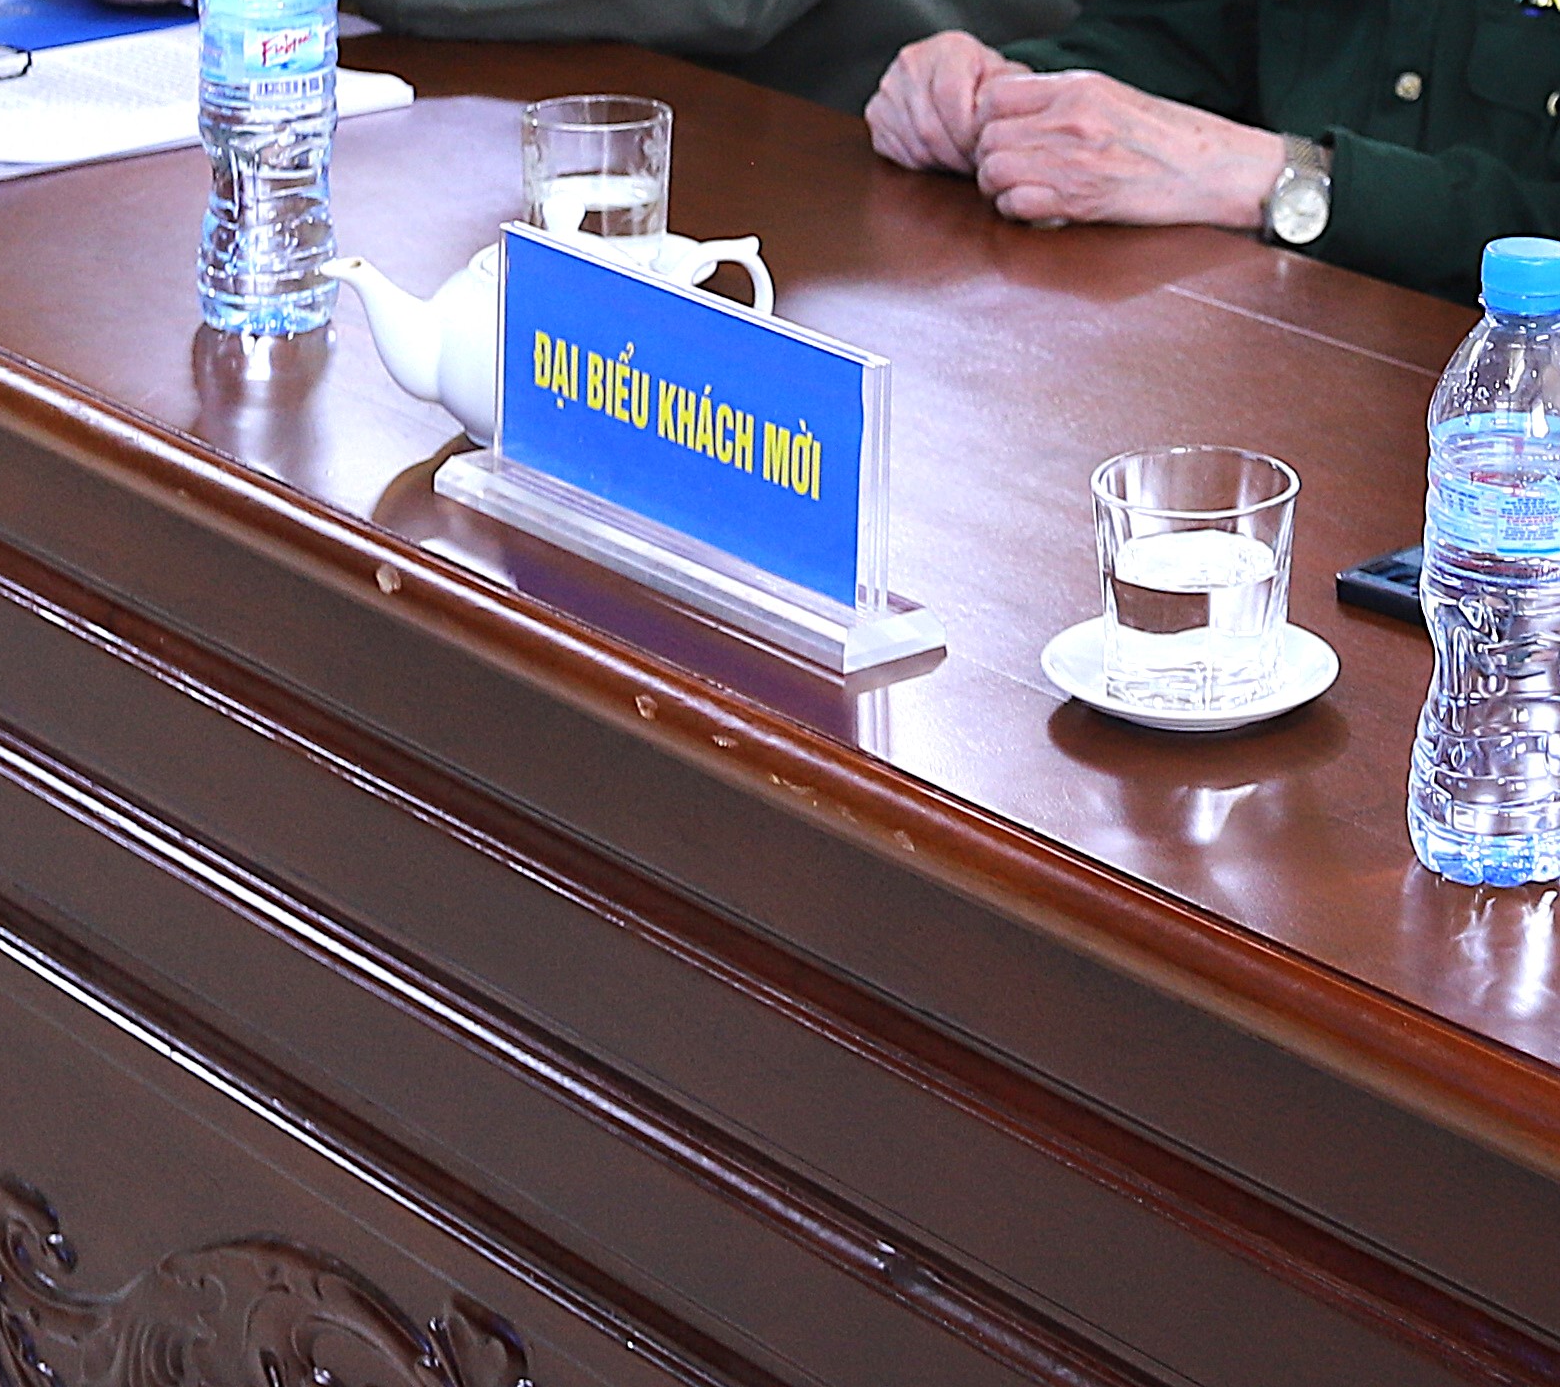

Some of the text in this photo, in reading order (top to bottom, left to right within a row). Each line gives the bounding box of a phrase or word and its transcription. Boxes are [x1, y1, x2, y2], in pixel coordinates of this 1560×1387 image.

[533, 330, 821, 502] ĐẠI BIỂU KHÁCH MỜI
